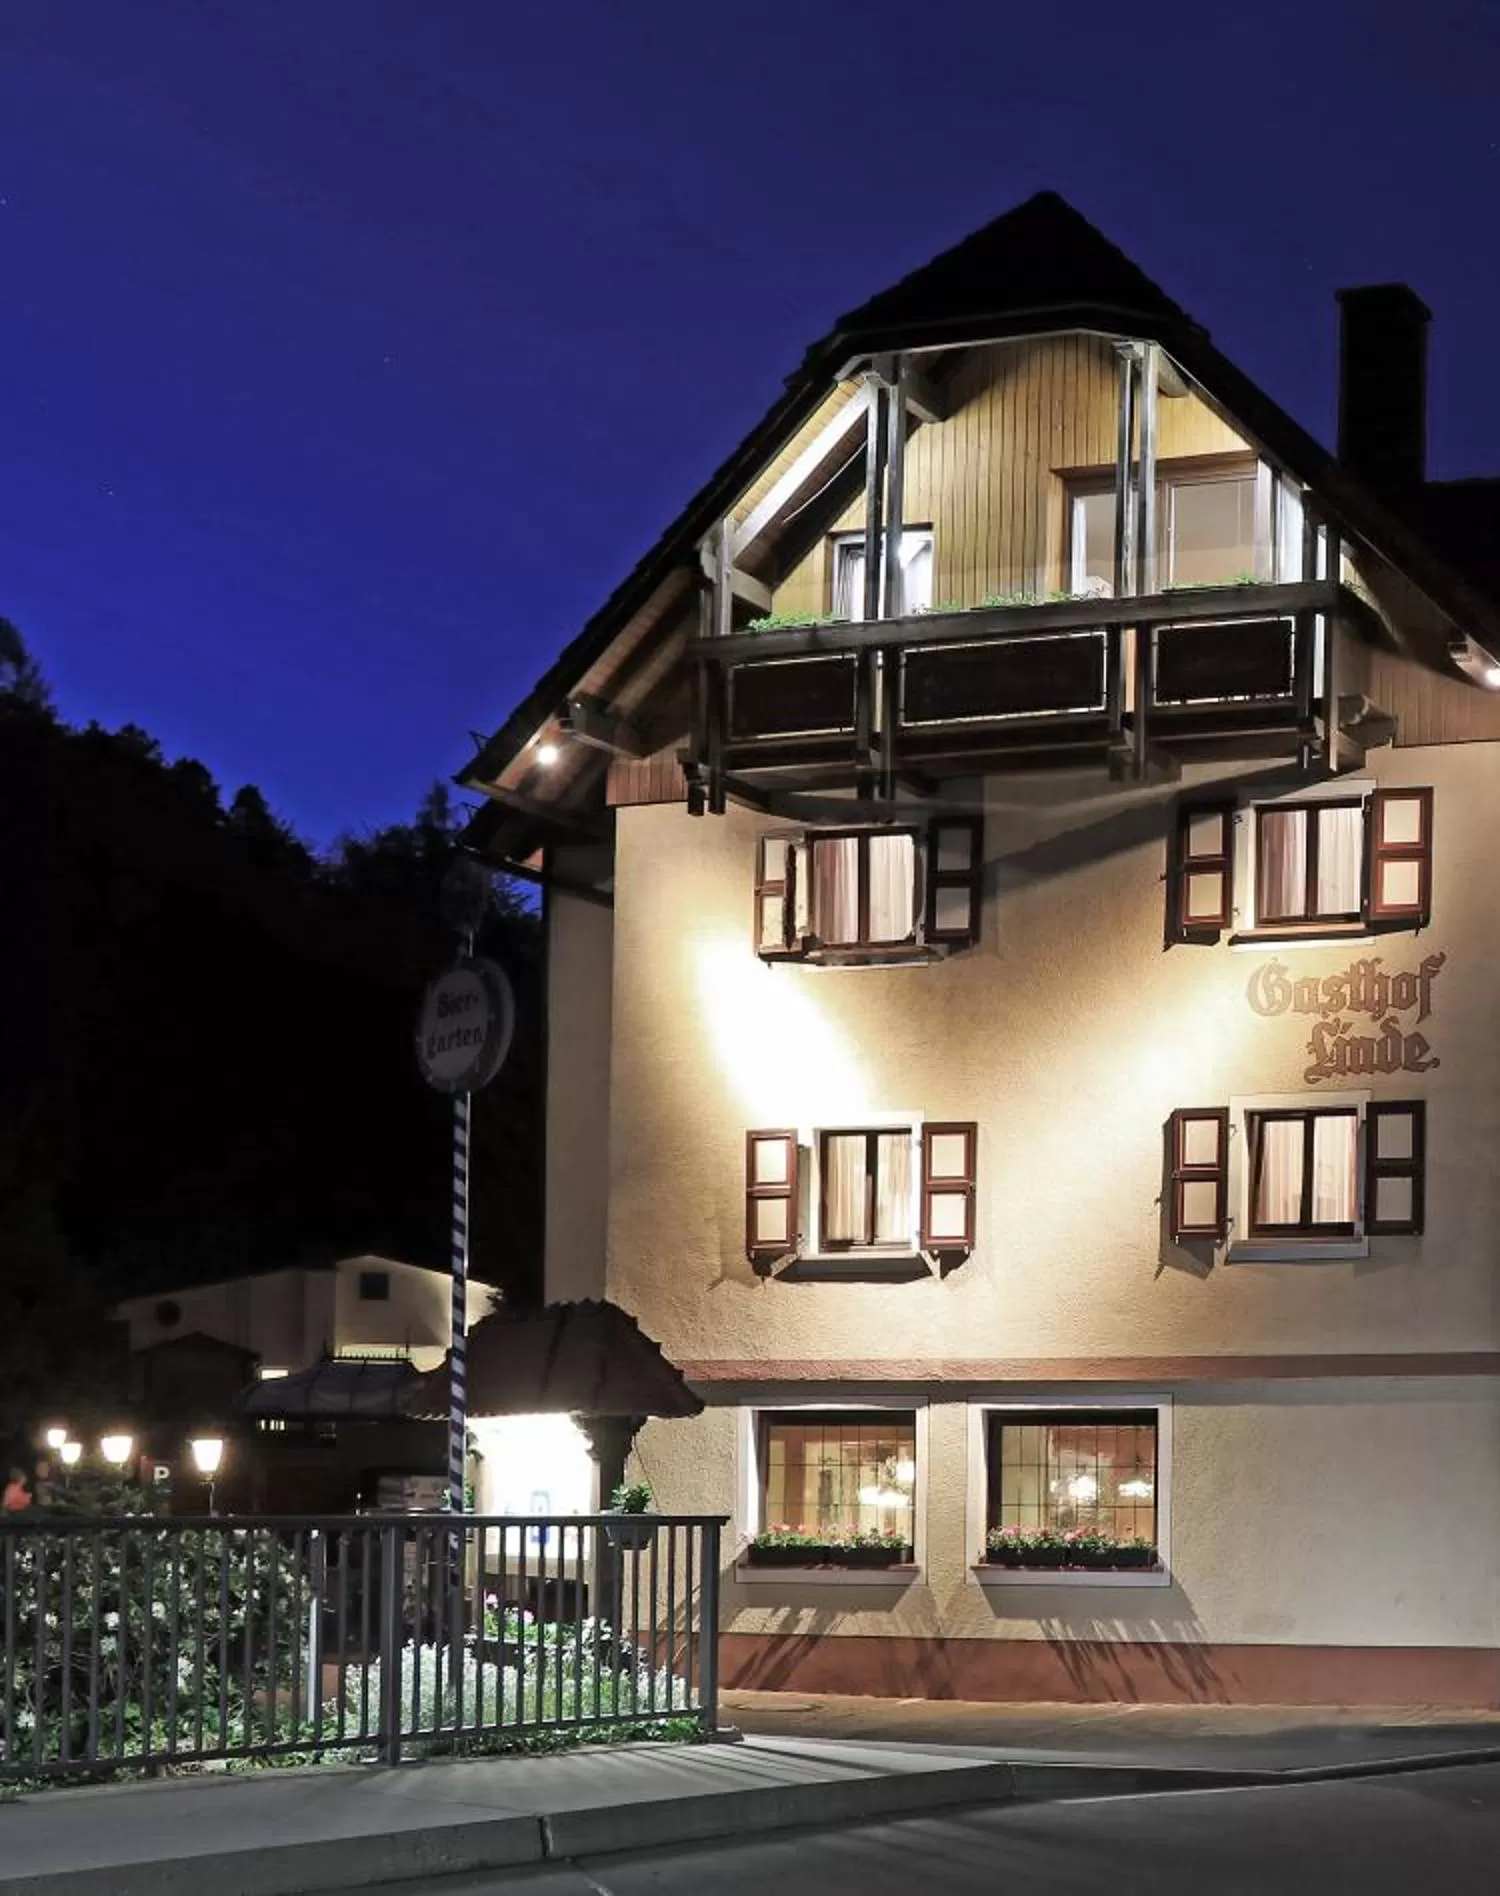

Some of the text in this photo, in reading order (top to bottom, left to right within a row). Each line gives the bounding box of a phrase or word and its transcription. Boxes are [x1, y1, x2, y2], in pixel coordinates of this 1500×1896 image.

[1246, 952, 1446, 1024] Gasthof
[1304, 1015, 1440, 1084] Linde
[153, 1466, 171, 1486] P
